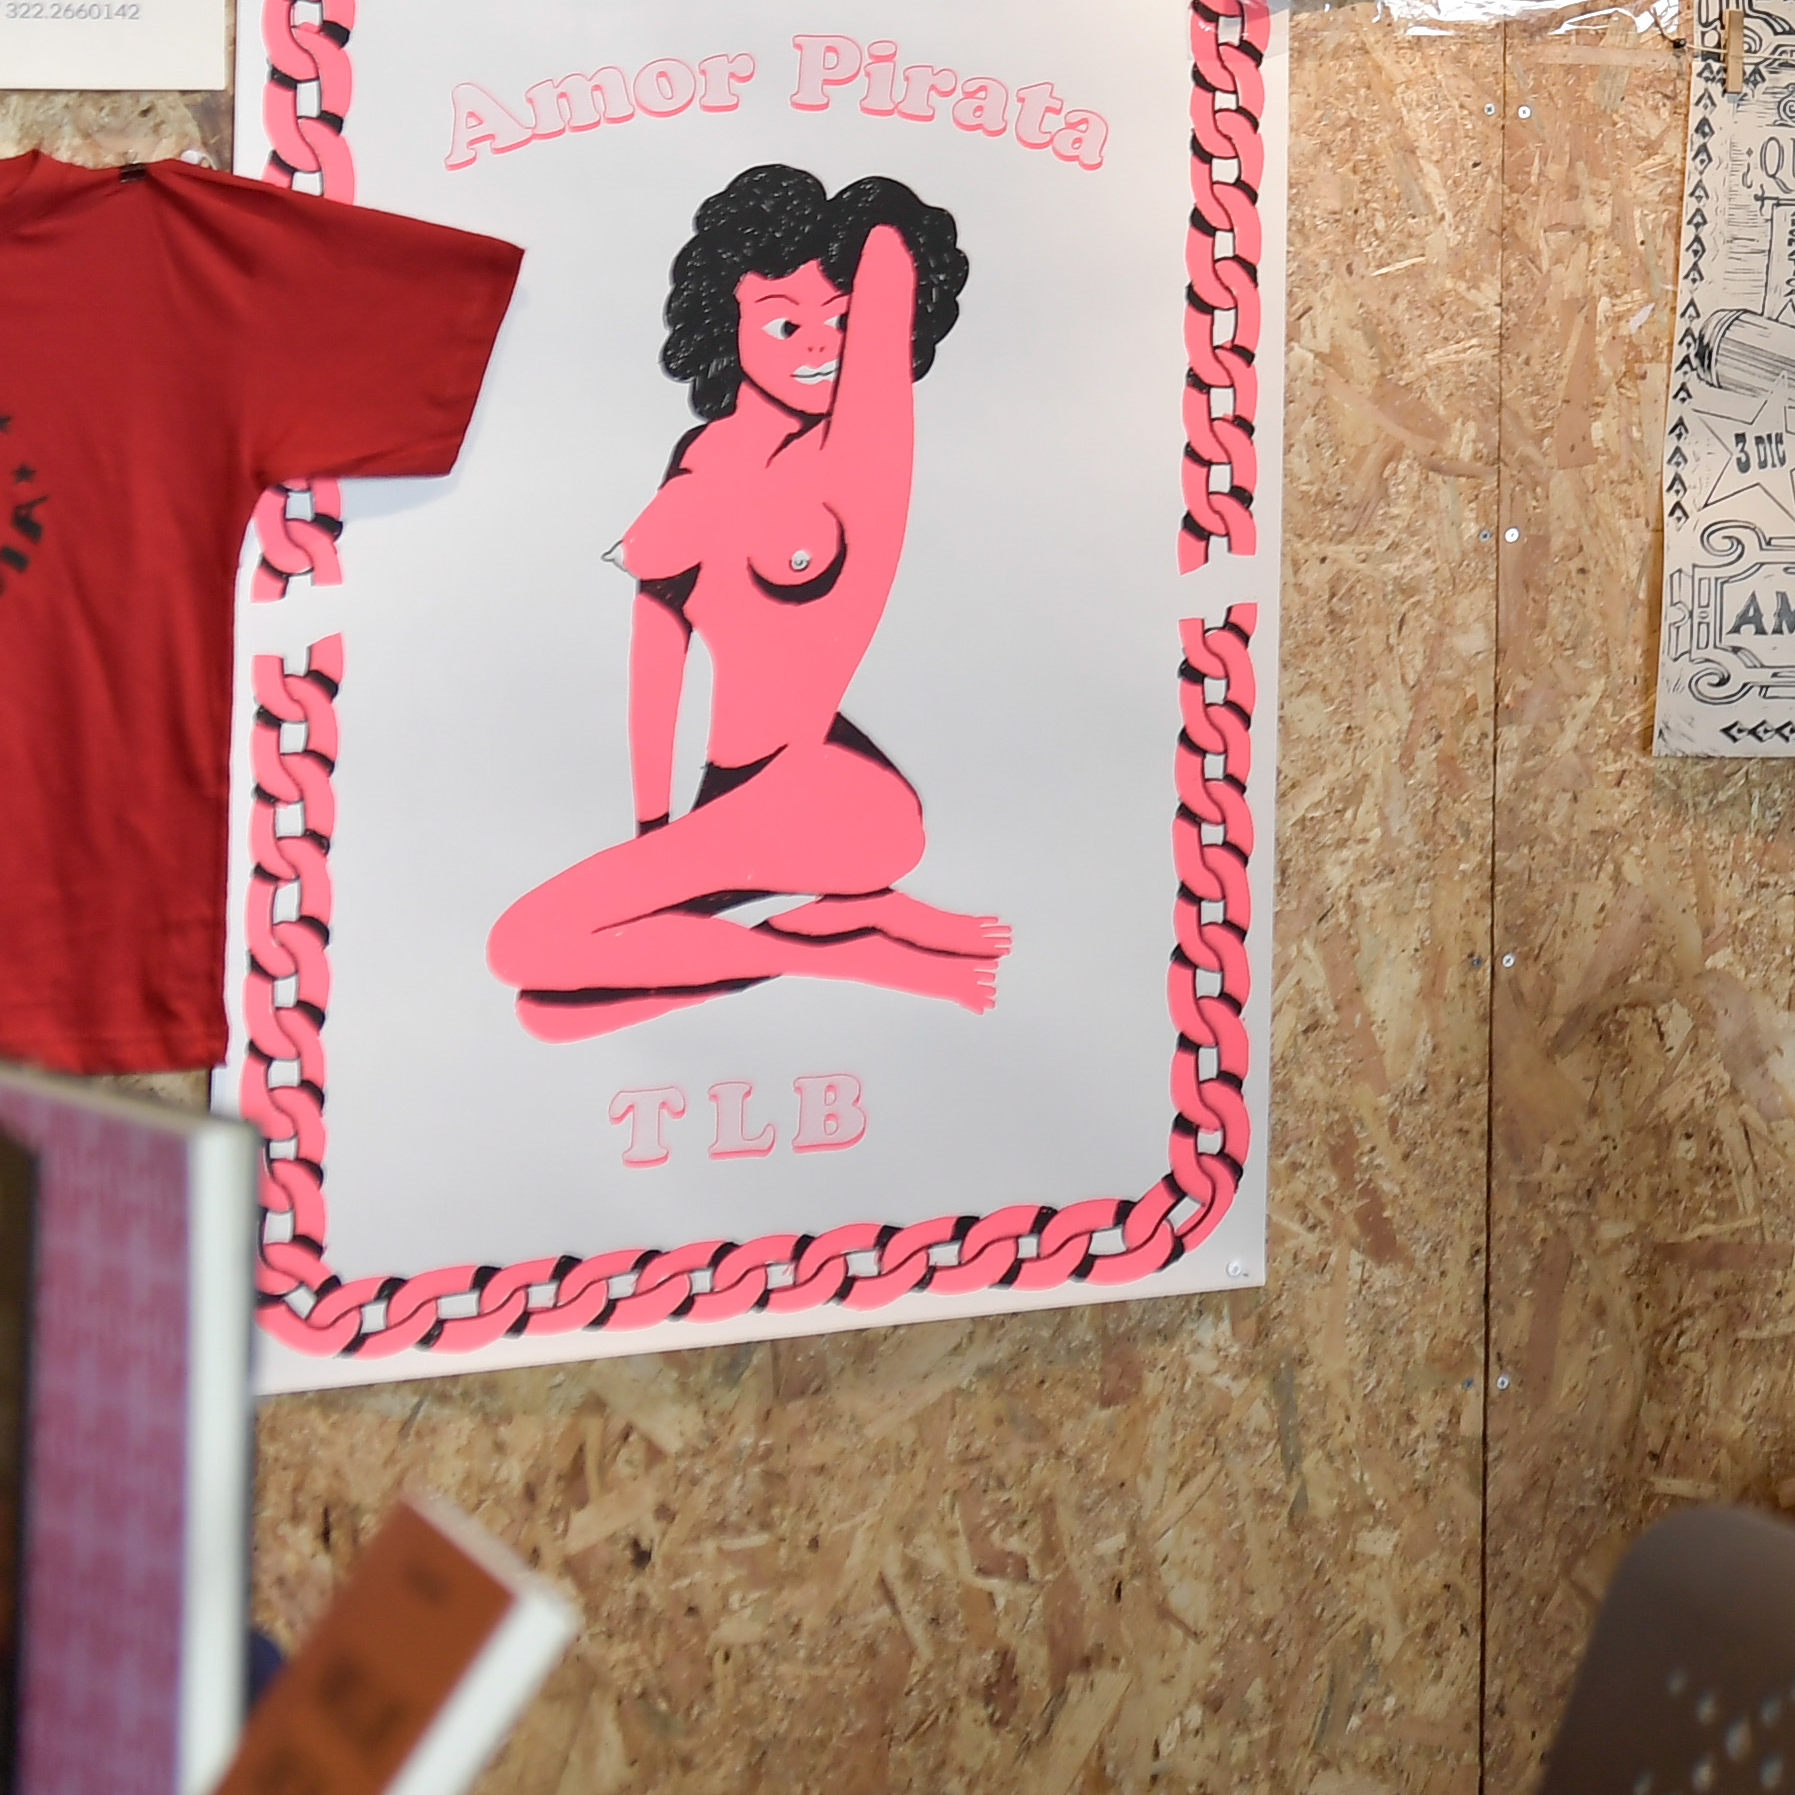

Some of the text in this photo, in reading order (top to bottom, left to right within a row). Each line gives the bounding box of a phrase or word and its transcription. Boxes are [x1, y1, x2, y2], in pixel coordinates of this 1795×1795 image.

[5, 2, 141, 21] 322.2660142
[444, 33, 1110, 171] Amor Pirata
[1735, 431, 1787, 475] 3 DIC
